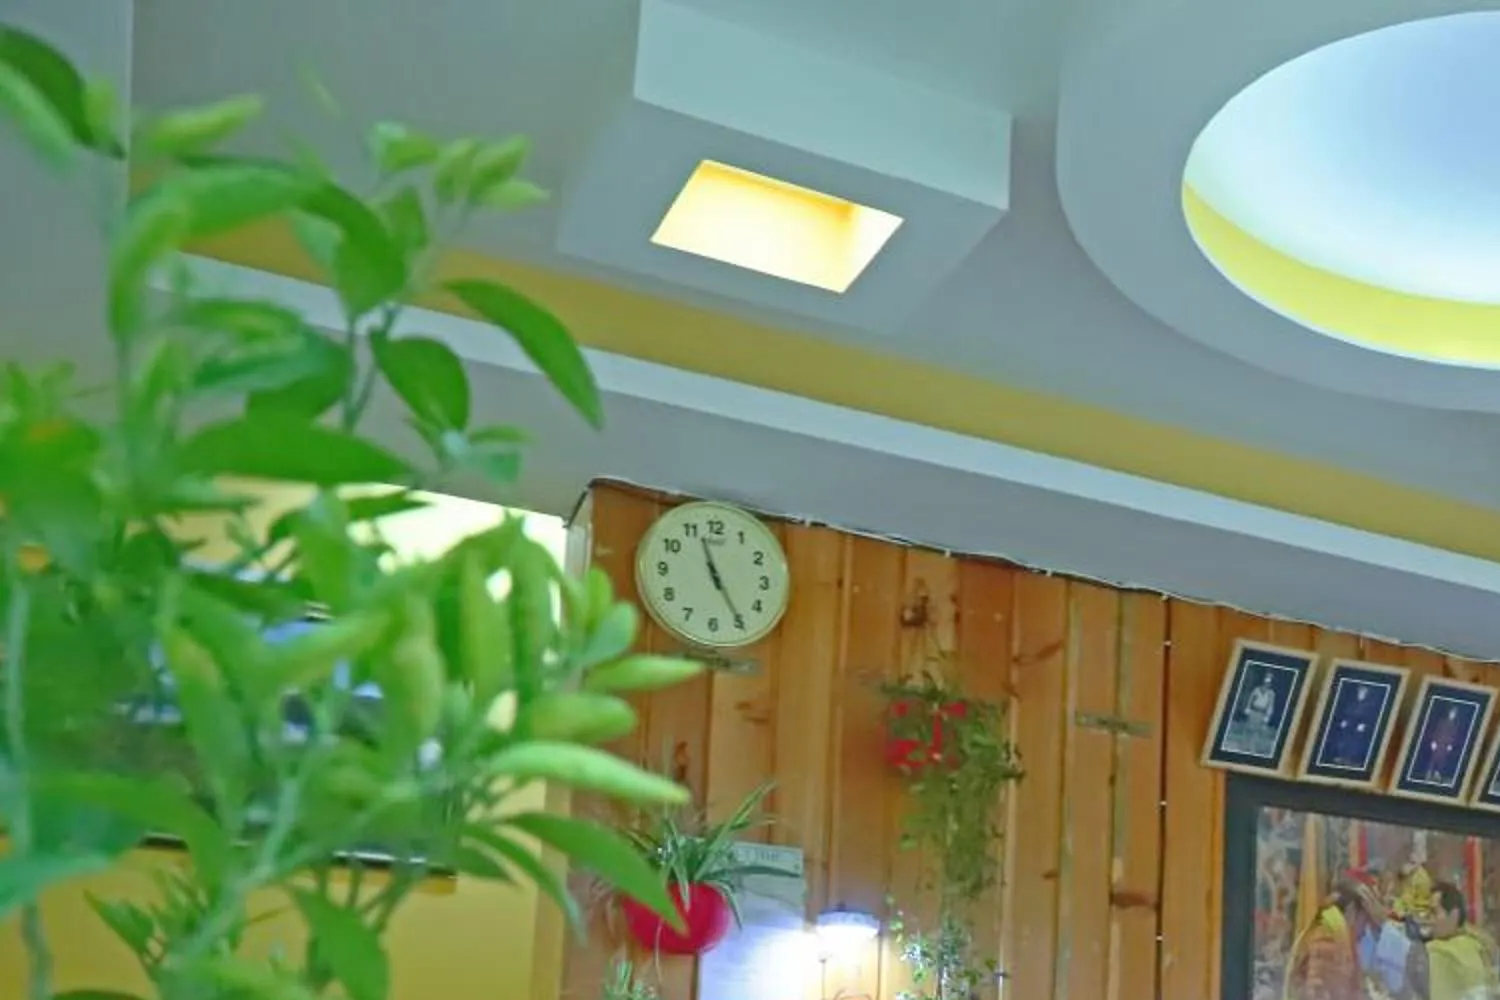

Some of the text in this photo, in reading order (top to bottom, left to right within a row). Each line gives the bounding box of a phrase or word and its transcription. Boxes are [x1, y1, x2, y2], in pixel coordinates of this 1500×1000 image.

[683, 523, 697, 537] 11
[706, 520, 724, 535] 12
[737, 531, 744, 544] 1
[664, 538, 681, 553] 10
[753, 551, 764, 565] 2
[657, 561, 668, 576] 9
[759, 576, 769, 590] 3
[663, 587, 675, 601] 8
[752, 600, 762, 613] 4
[682, 607, 693, 621] 7
[707, 617, 718, 632] 6
